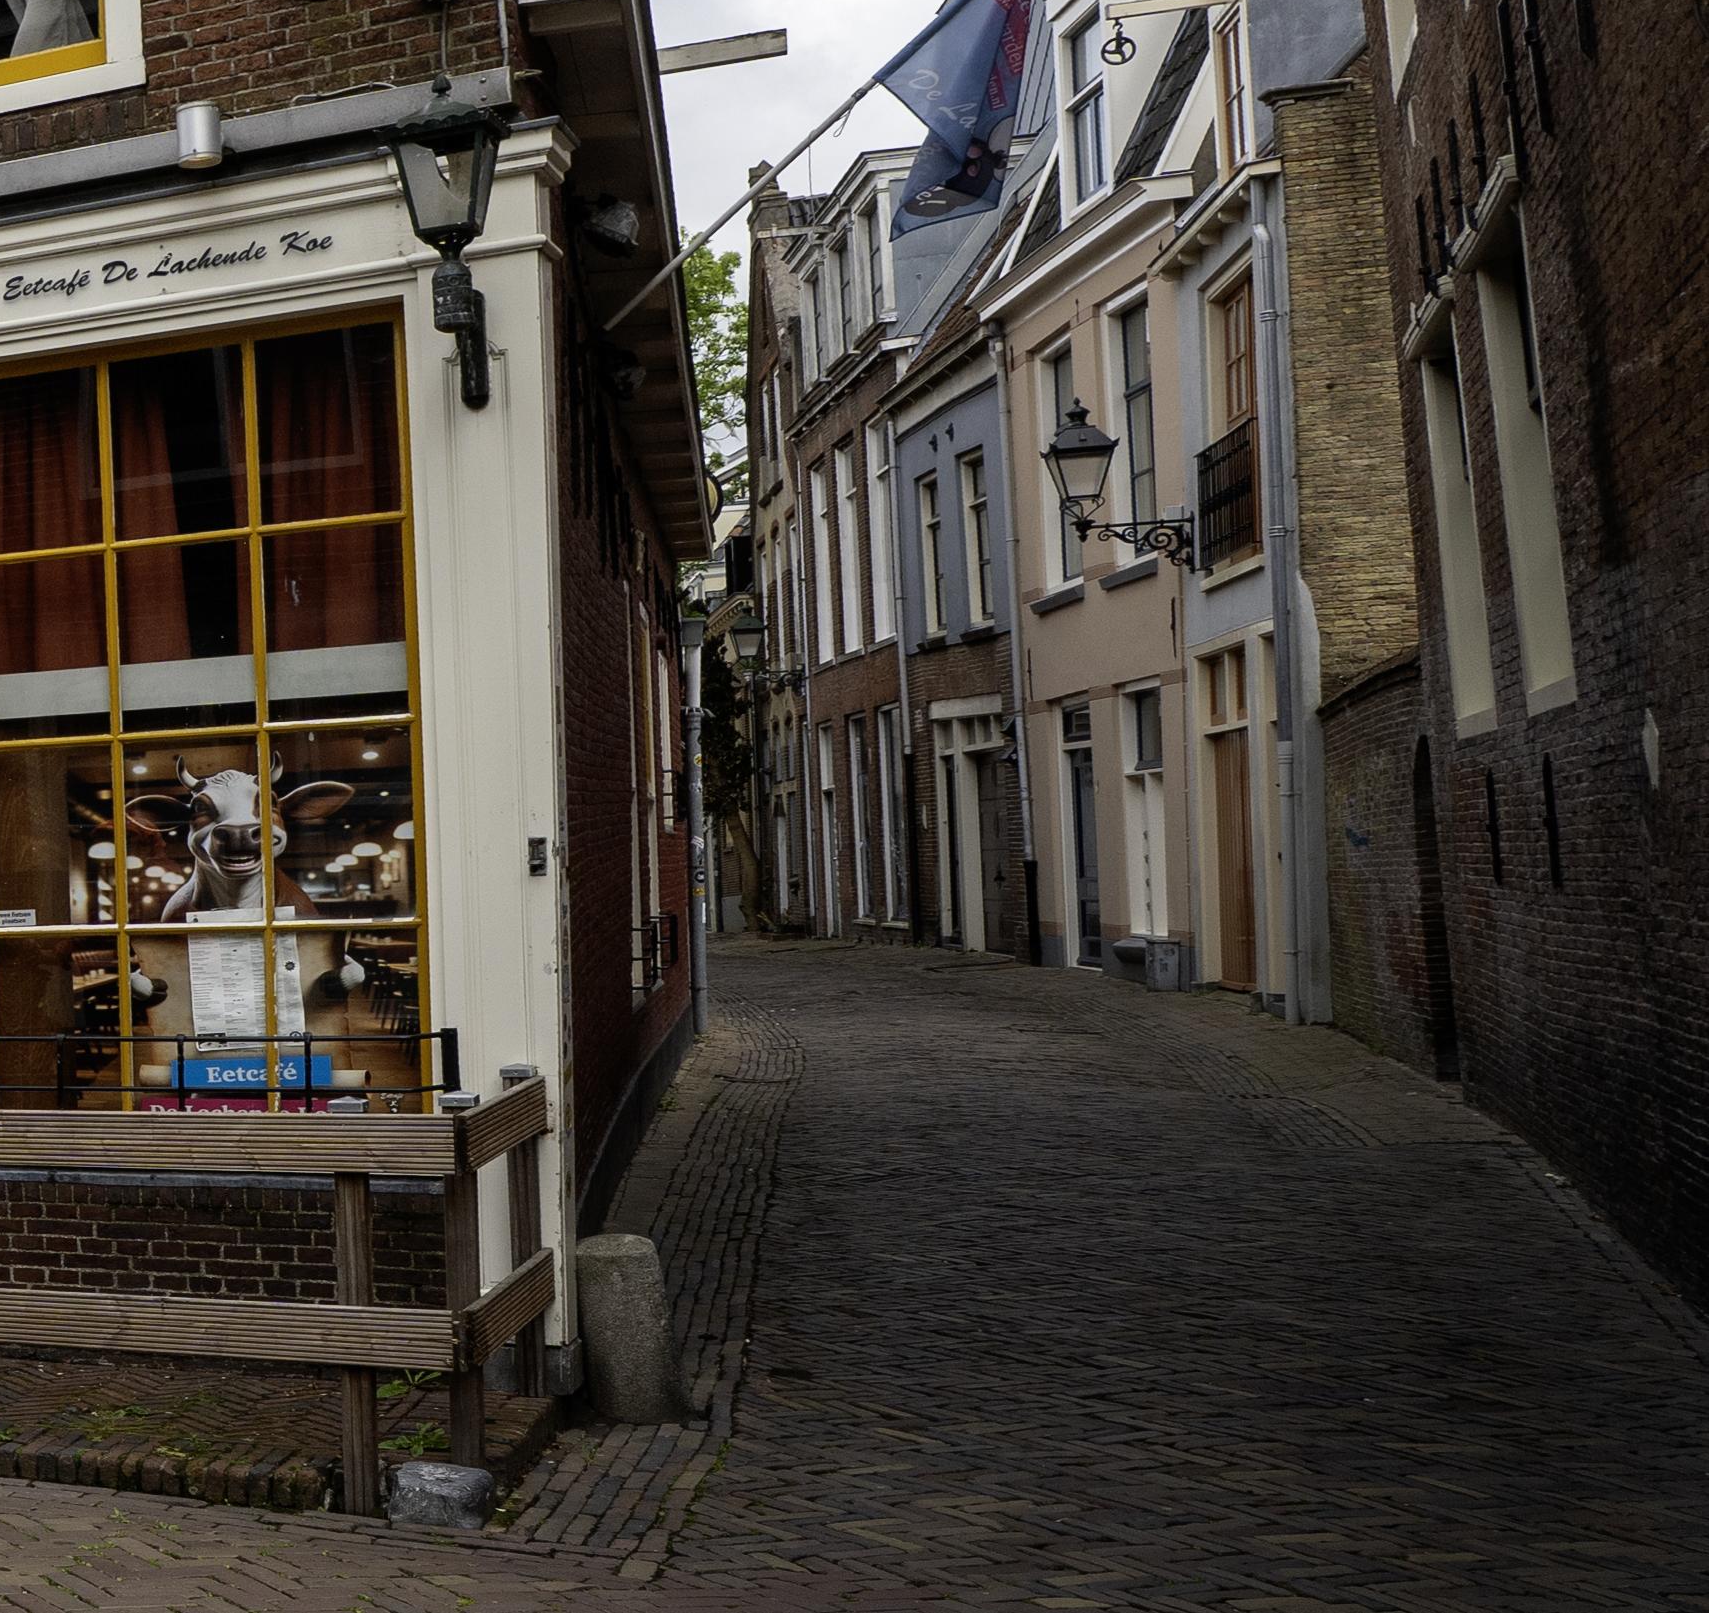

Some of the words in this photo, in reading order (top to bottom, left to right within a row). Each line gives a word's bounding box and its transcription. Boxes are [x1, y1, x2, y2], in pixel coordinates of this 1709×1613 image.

[3, 269, 90, 301] Eetcafé
[102, 260, 139, 284] De
[147, 242, 267, 278] Lachende
[279, 231, 333, 256] Koe
